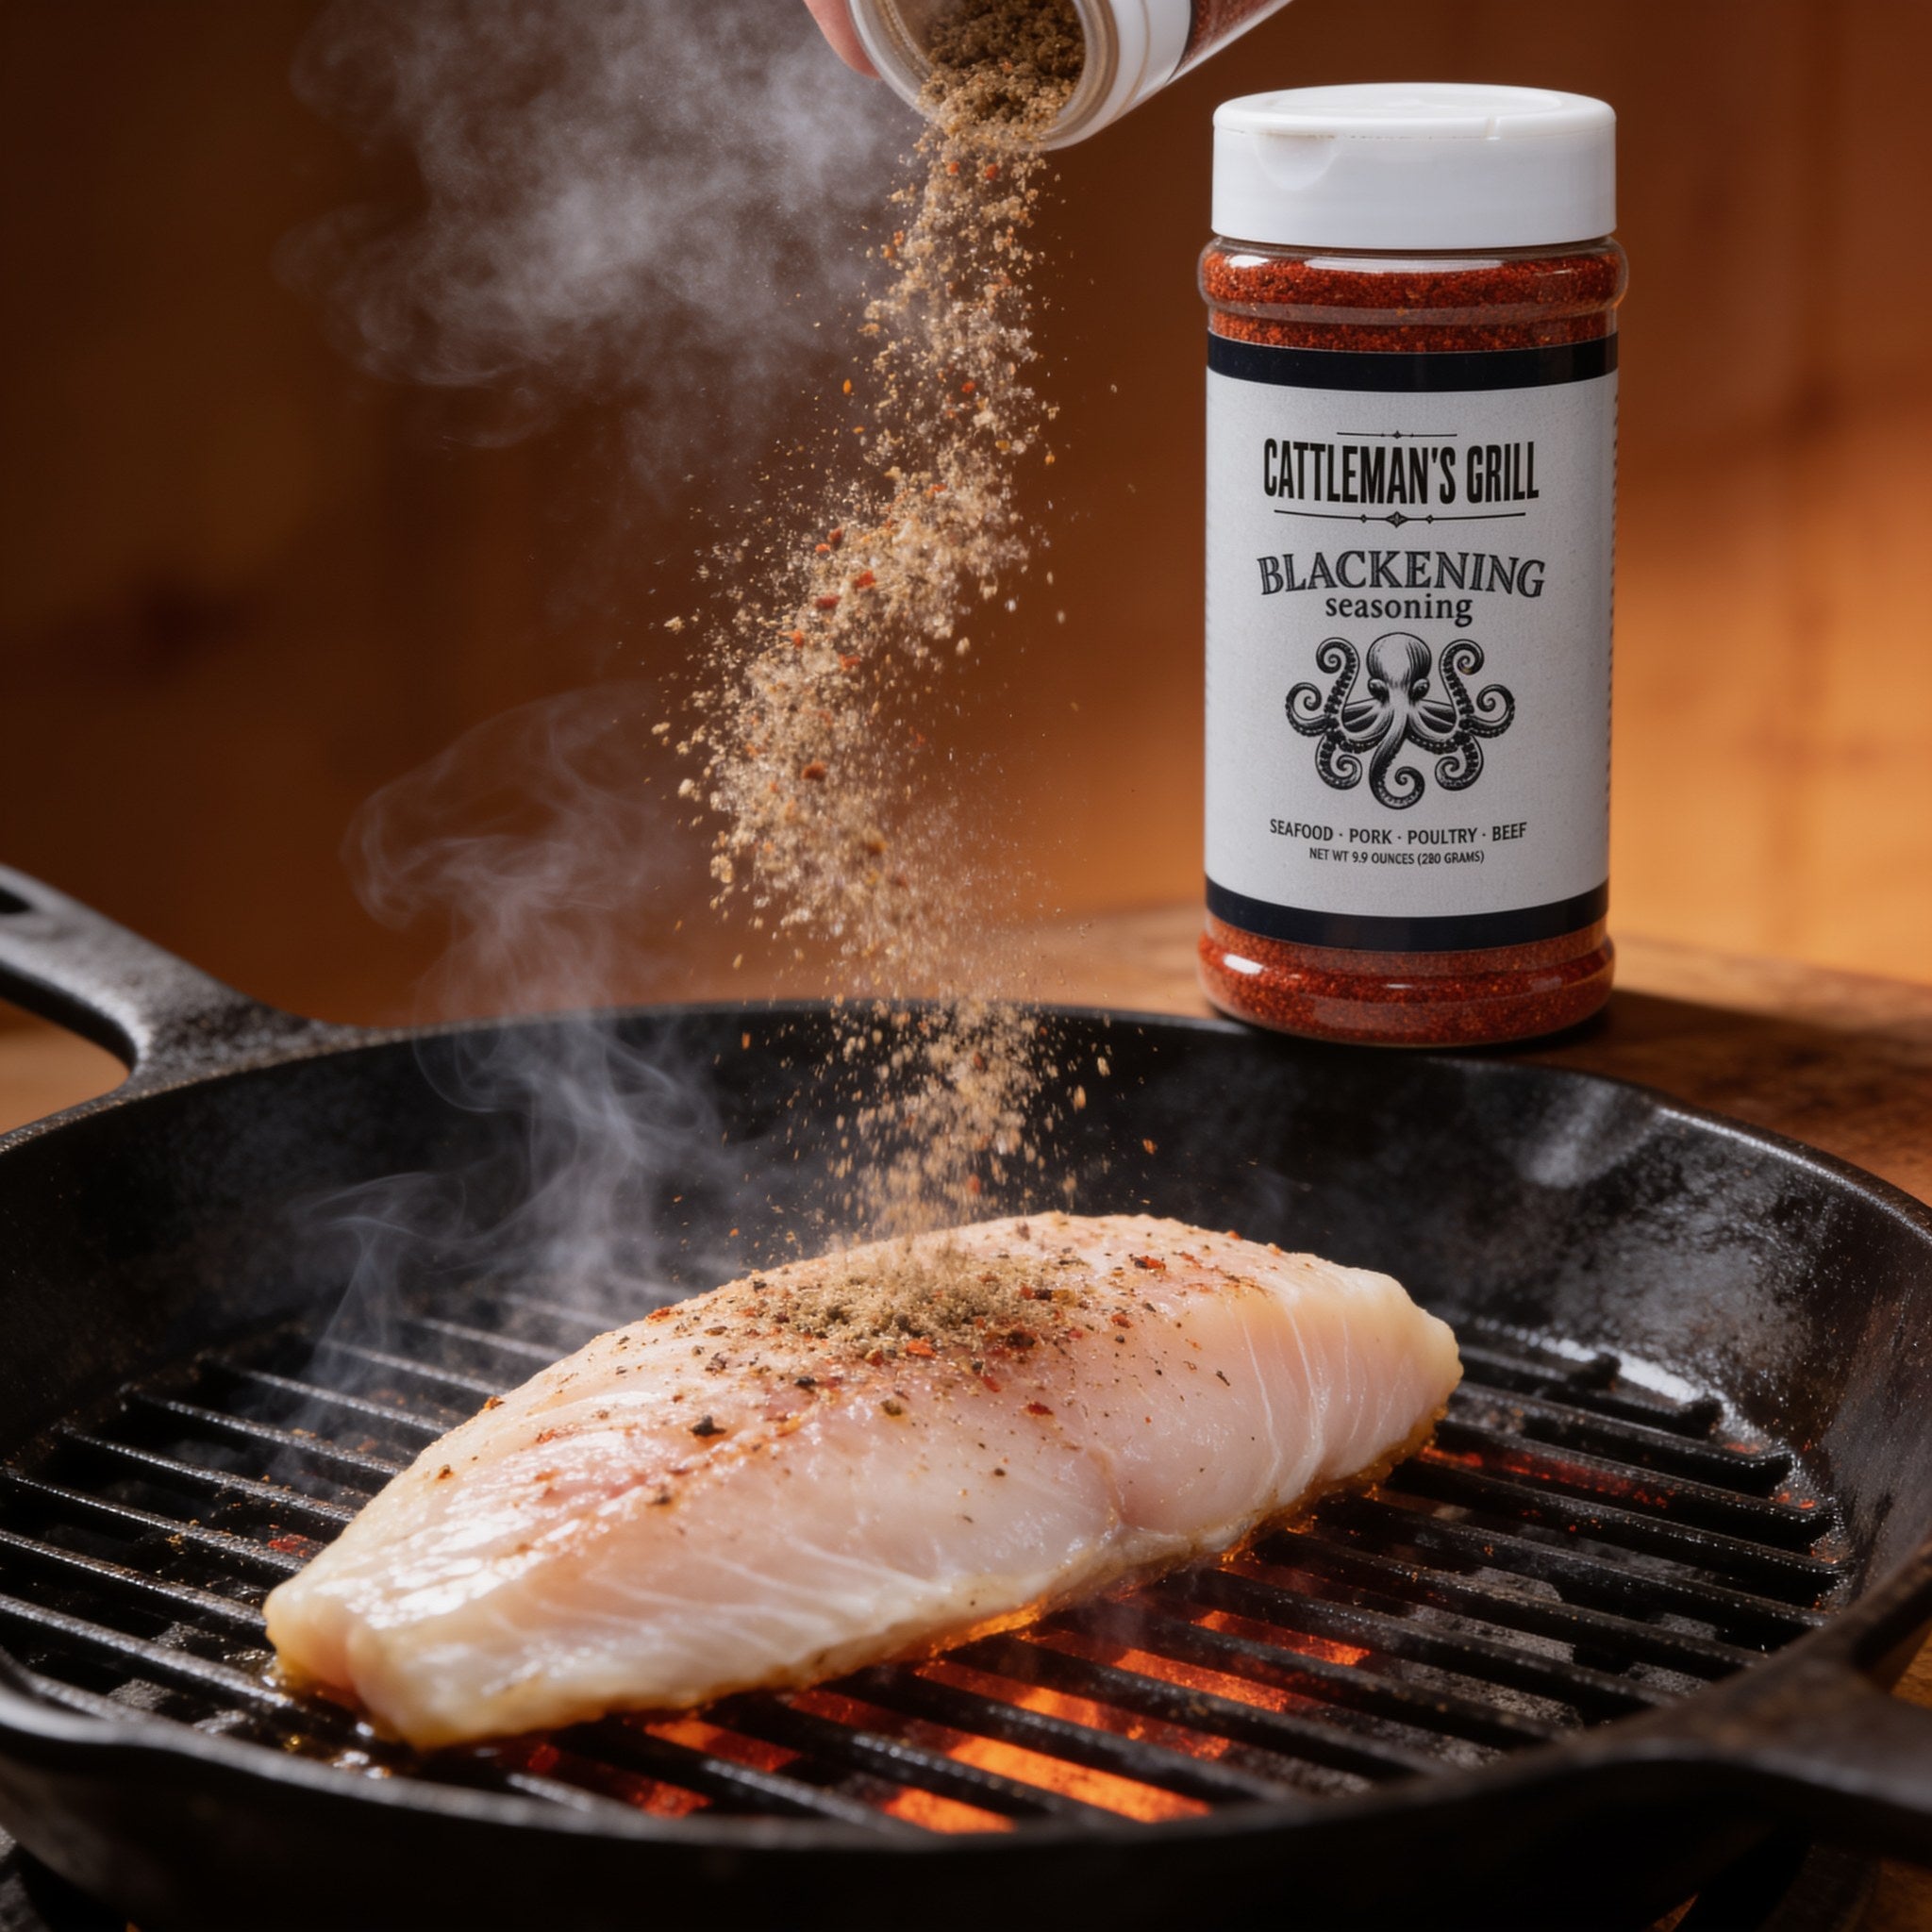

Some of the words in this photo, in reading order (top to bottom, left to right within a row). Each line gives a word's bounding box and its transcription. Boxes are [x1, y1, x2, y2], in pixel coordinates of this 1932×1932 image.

[1264, 438, 1456, 504] CATTLEMAN'S
[1466, 441, 1540, 504] GRILL
[1257, 550, 1545, 598] BLACKENING
[1325, 592, 1473, 628] seasoning
[1270, 819, 1334, 841] SEAFOOD
[1349, 828, 1392, 844] PORK
[1407, 828, 1477, 844] POULTRY
[1492, 822, 1527, 841] BEEF
[1309, 847, 1329, 860] NET
[1332, 850, 1349, 861] WT
[1353, 852, 1368, 864] 9.9
[1372, 853, 1415, 864] OUNCES
[1417, 853, 1441, 866] (280
[1444, 850, 1485, 864] GRAMS)
